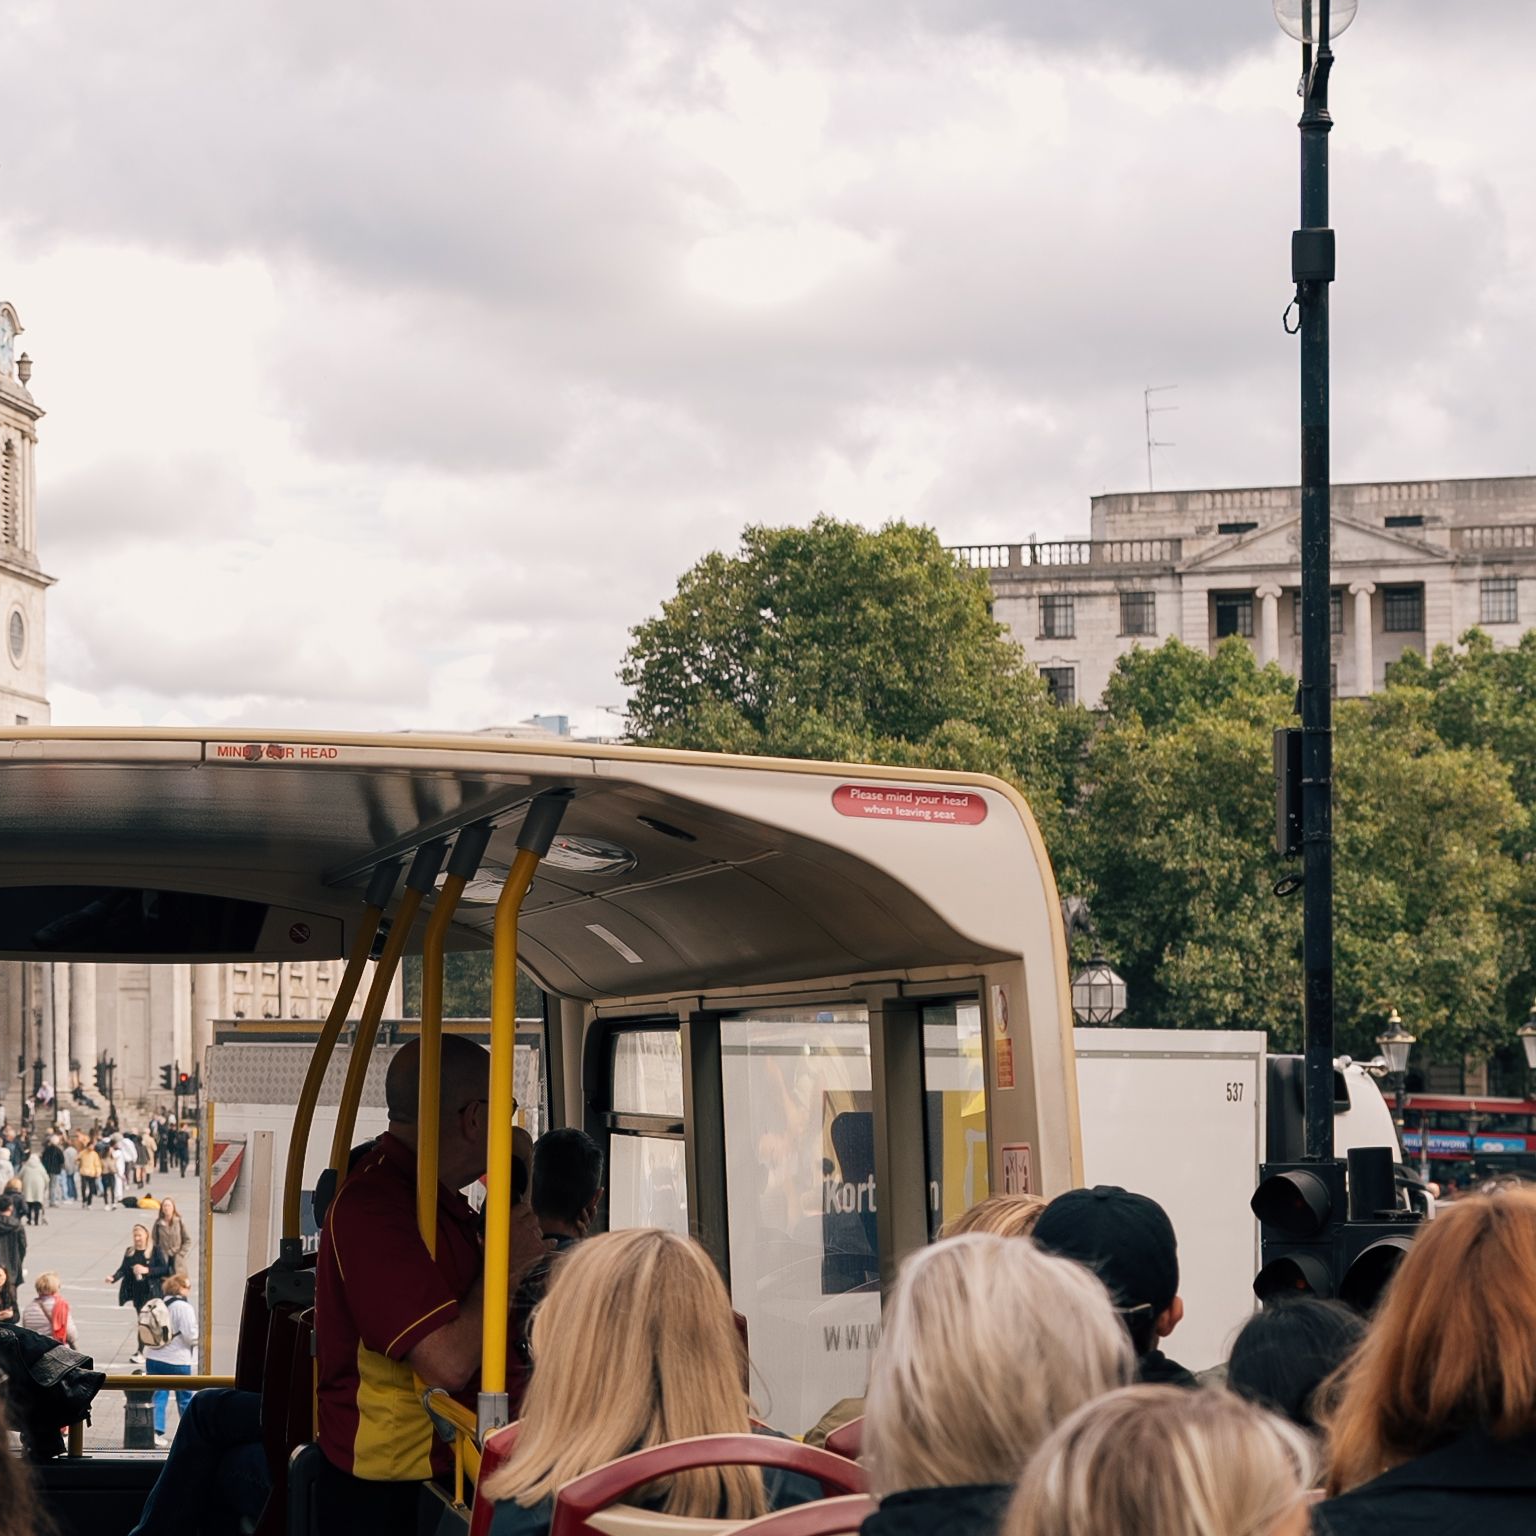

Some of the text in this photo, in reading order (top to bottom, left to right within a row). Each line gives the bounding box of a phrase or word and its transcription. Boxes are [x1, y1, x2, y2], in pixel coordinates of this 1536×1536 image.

[300, 747, 338, 759] HEAD
[850, 788, 969, 807] Please mind your head
[863, 804, 956, 820] when leaving seat
[1226, 1082, 1244, 1102] 537
